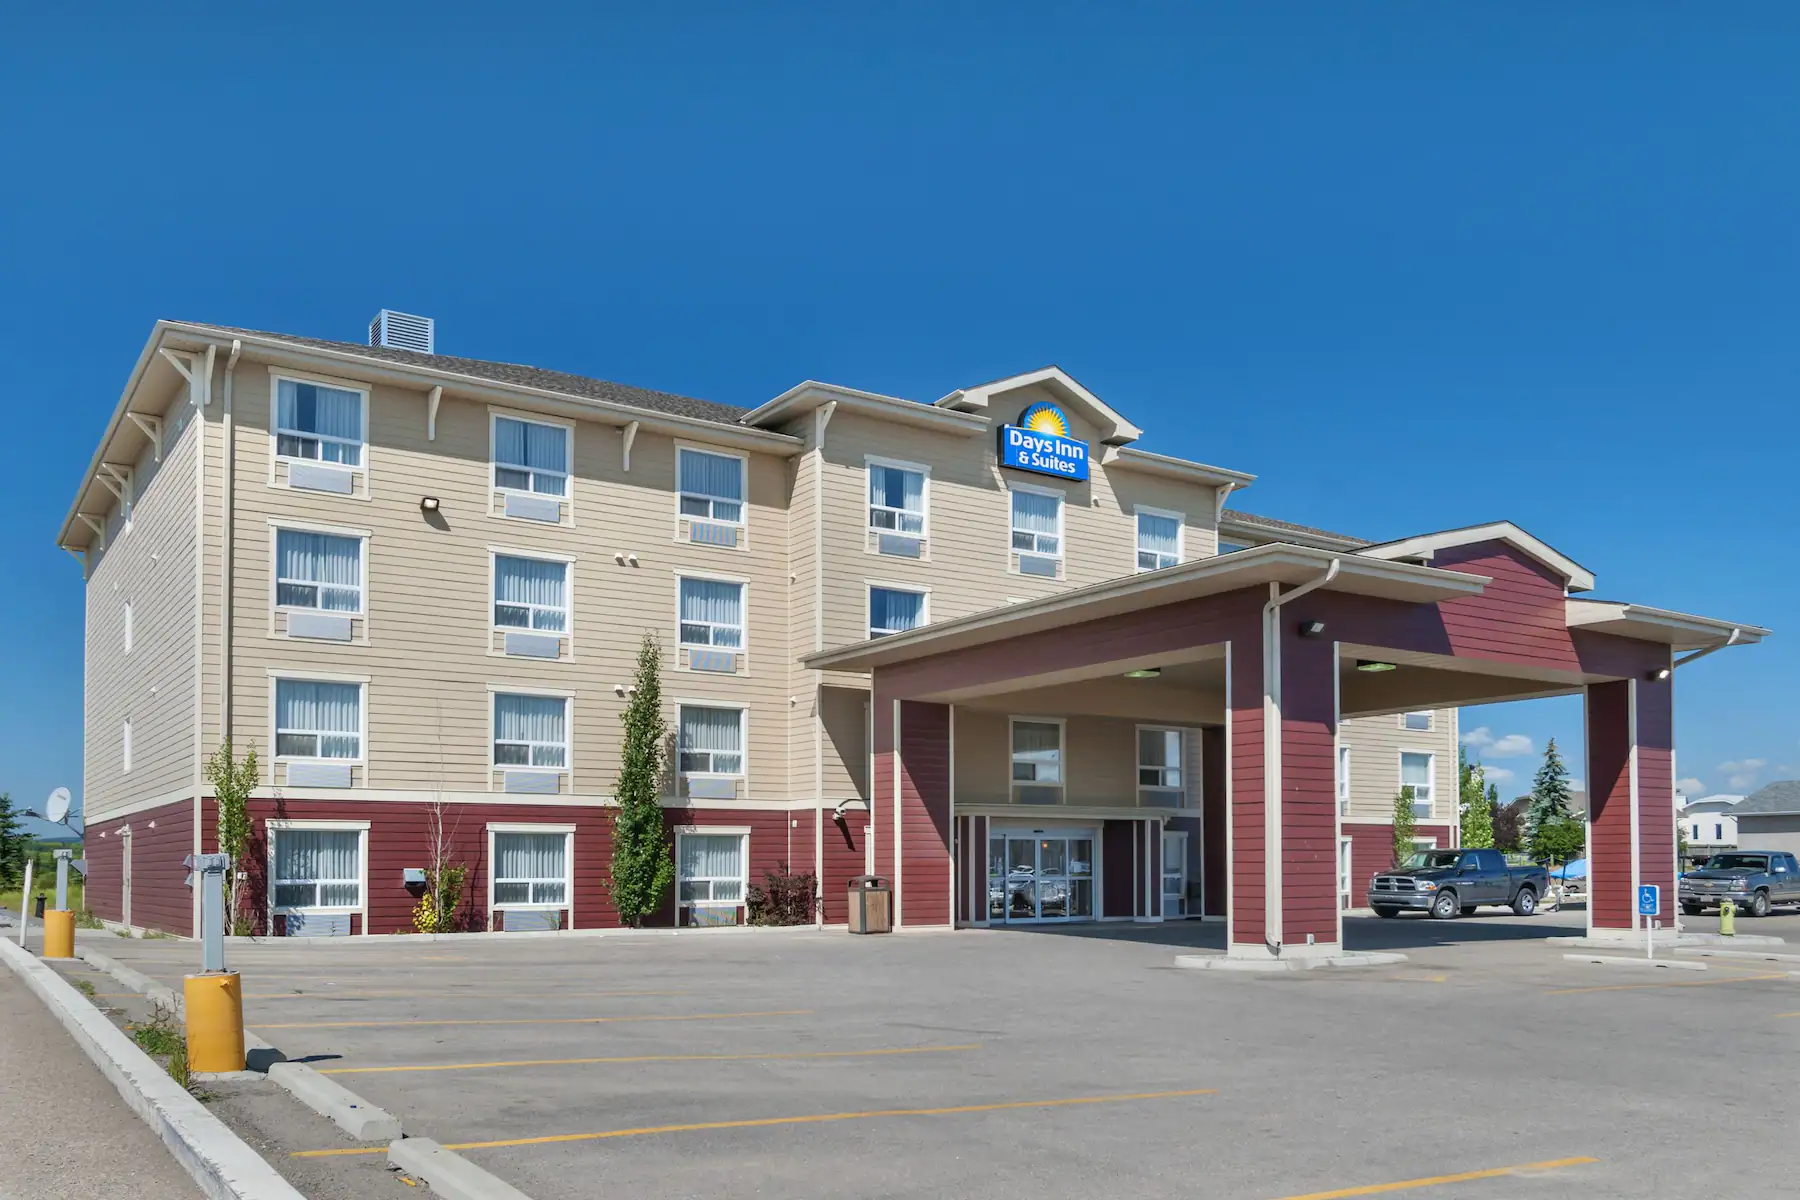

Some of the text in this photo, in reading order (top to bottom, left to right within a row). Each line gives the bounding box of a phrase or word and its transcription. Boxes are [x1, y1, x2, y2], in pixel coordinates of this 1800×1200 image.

[1009, 429, 1084, 460] Days Inn
[1019, 451, 1076, 474] & Suites
